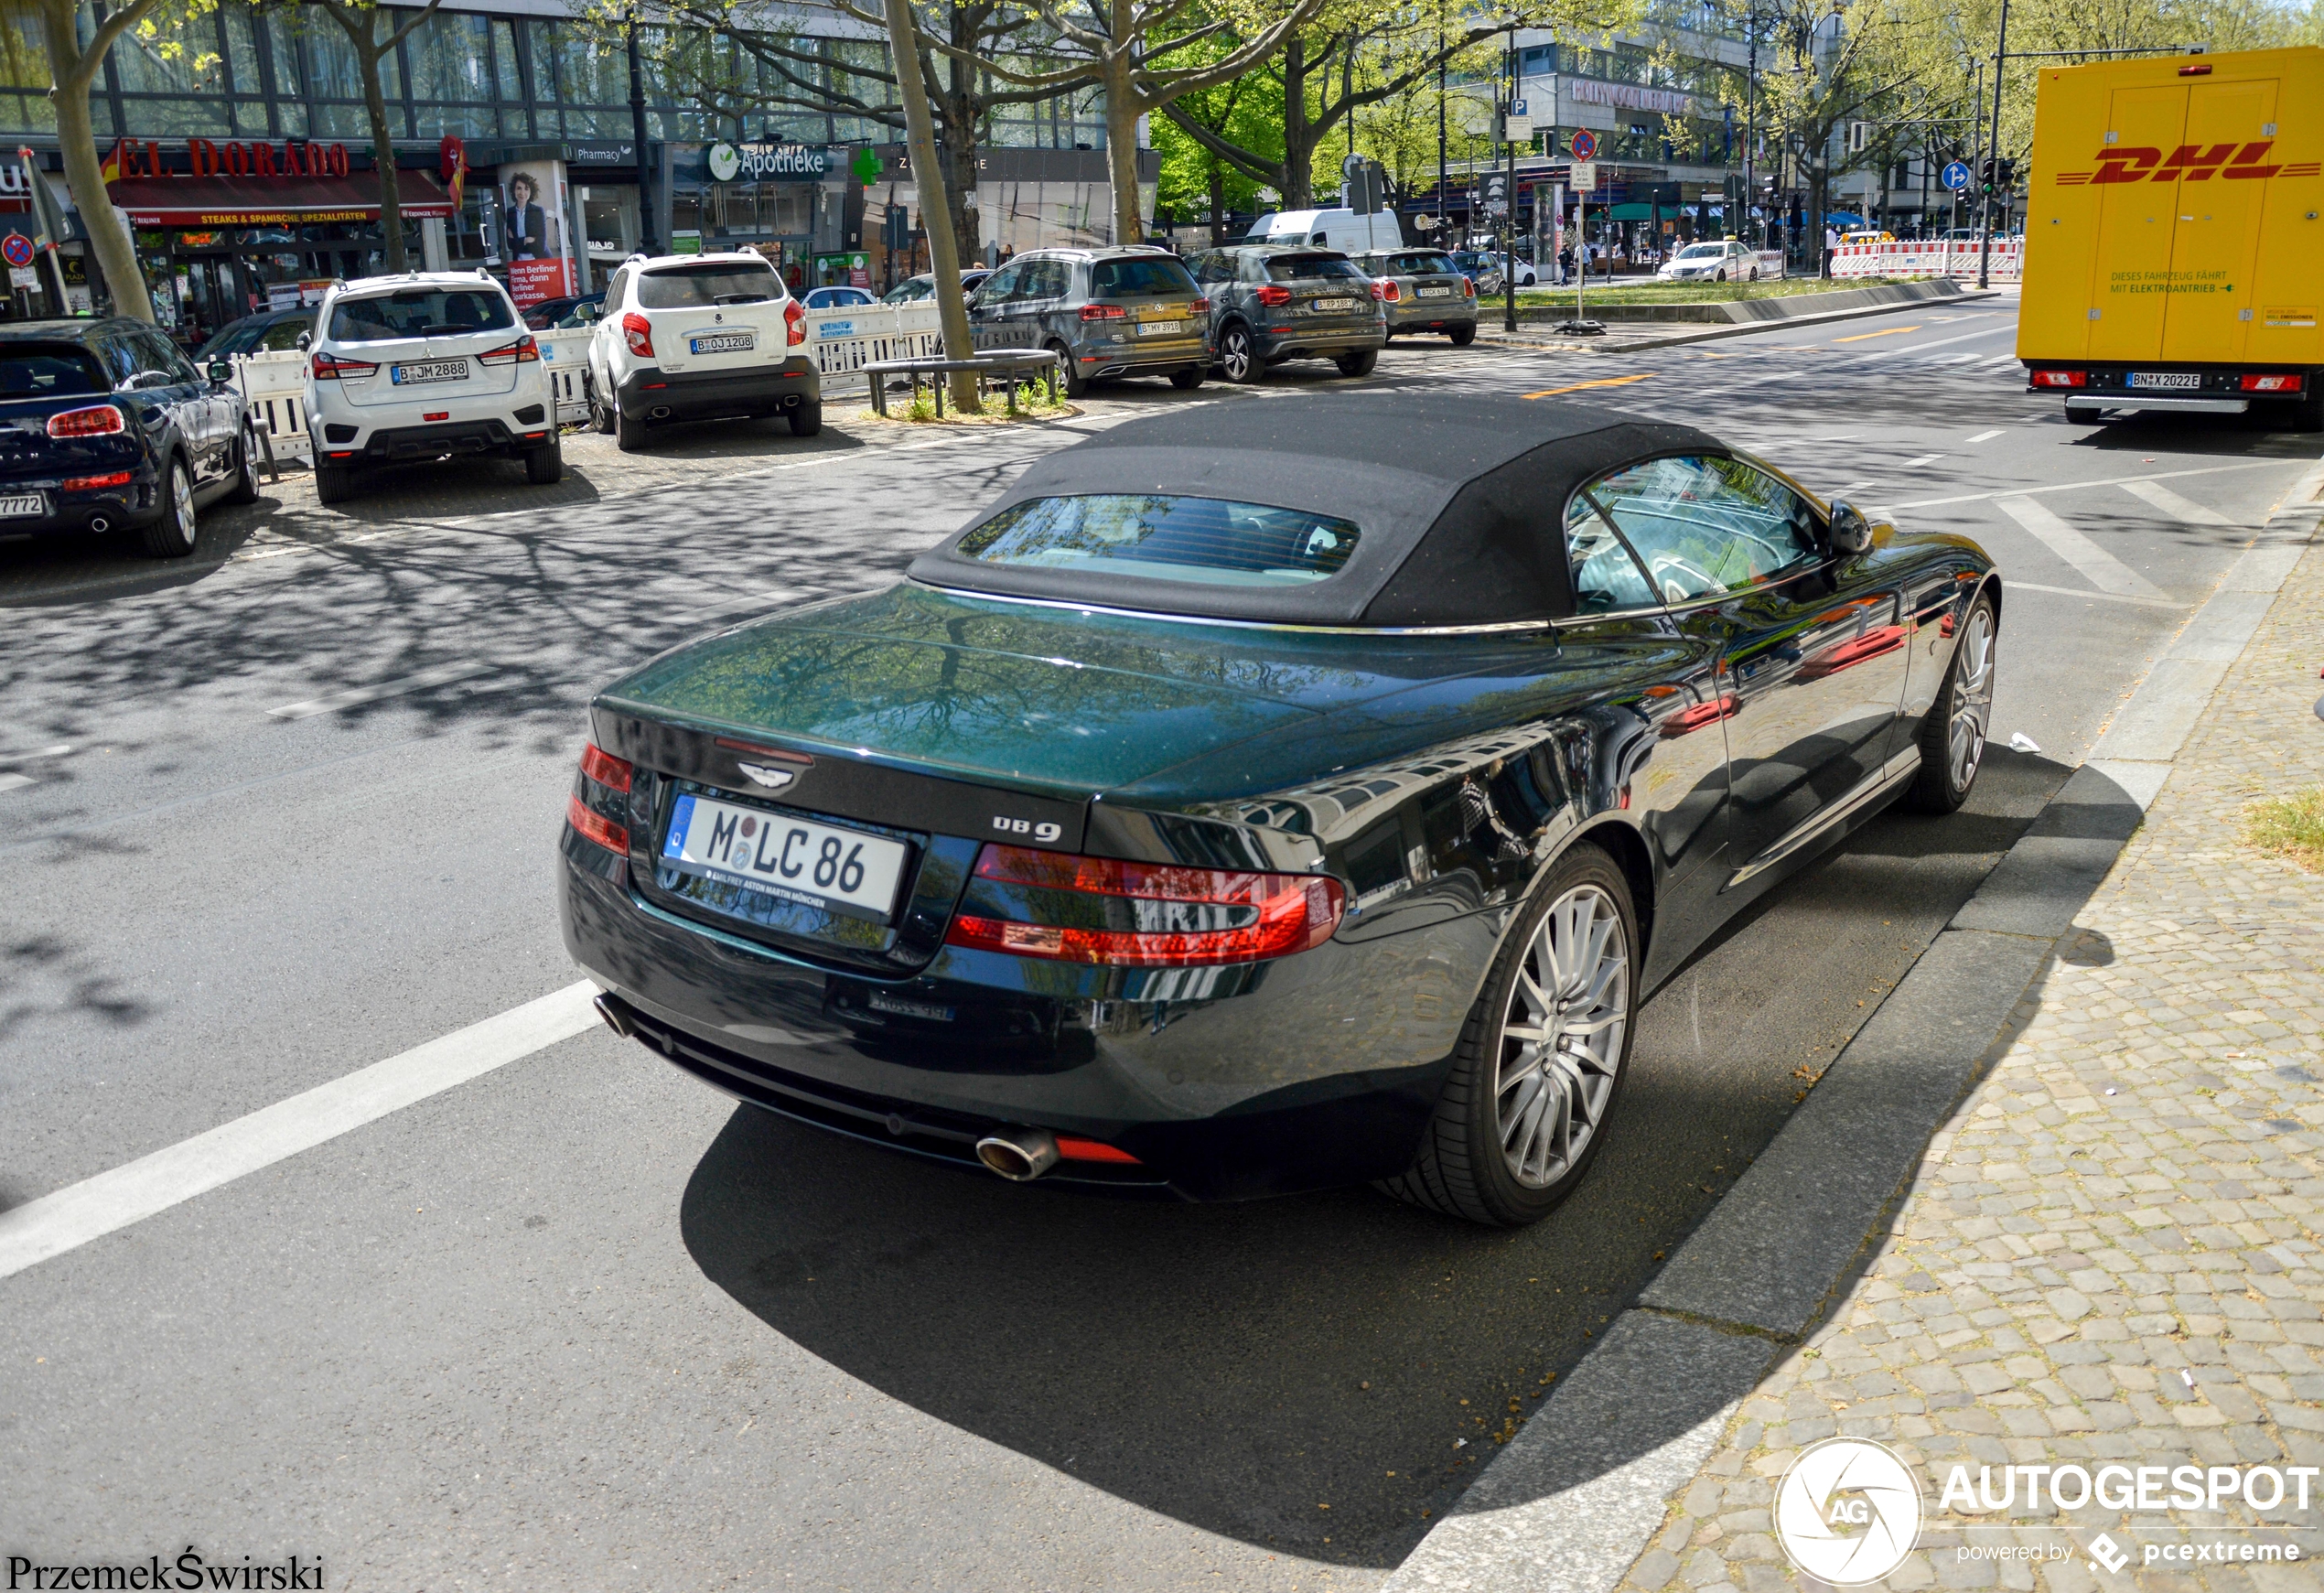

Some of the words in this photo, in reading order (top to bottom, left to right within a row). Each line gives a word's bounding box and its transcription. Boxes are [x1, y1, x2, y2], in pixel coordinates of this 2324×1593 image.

[1572, 80, 1640, 107] HOLLYWOOD
[114, 138, 173, 178] EL
[187, 138, 350, 178] DORADO
[578, 148, 620, 162] Pharmacy
[741, 148, 823, 179] Apotheke
[2089, 141, 2284, 184] DHL
[201, 214, 239, 224] STEAKS
[241, 213, 247, 223] &
[250, 212, 300, 223] SPANISCHE
[302, 211, 367, 222] SPEZIALITÄTEN
[510, 266, 526, 274] Wenn
[526, 264, 557, 274] Berliner
[2111, 272, 2142, 281] DIESES
[2144, 271, 2193, 281] FAHRZEUG
[2196, 270, 2227, 280] FÄHRT
[511, 275, 528, 284] Firma,
[529, 274, 549, 282] dann
[512, 284, 535, 292] Berliner
[1436, 287, 1447, 296] 632
[2110, 285, 2127, 293] MIT
[2129, 284, 2218, 293] ELEKTROANTRIEB.
[512, 291, 547, 301] Sparkasse.
[1318, 300, 1323, 308] B
[1326, 299, 1336, 308] RP
[1337, 298, 1352, 307] 1881
[1142, 325, 1147, 333] B
[1151, 323, 1161, 332] MY
[1162, 322, 1179, 331] 3918
[697, 340, 705, 350] B
[711, 339, 725, 349] OJ
[726, 337, 751, 348] 1208
[400, 368, 408, 380] B
[417, 366, 434, 379] JM
[435, 362, 466, 377] 2888
[2134, 374, 2148, 385] BN
[2155, 374, 2162, 386] X
[2163, 375, 2190, 386] 2022
[2192, 375, 2200, 387] E
[0, 497, 40, 513] 7772
[707, 811, 738, 862] M
[753, 822, 809, 878] LC
[813, 836, 865, 893] 86
[744, 879, 765, 893] ASTON
[766, 886, 791, 899] MARTIN
[791, 892, 825, 909] MÜNCHEN
